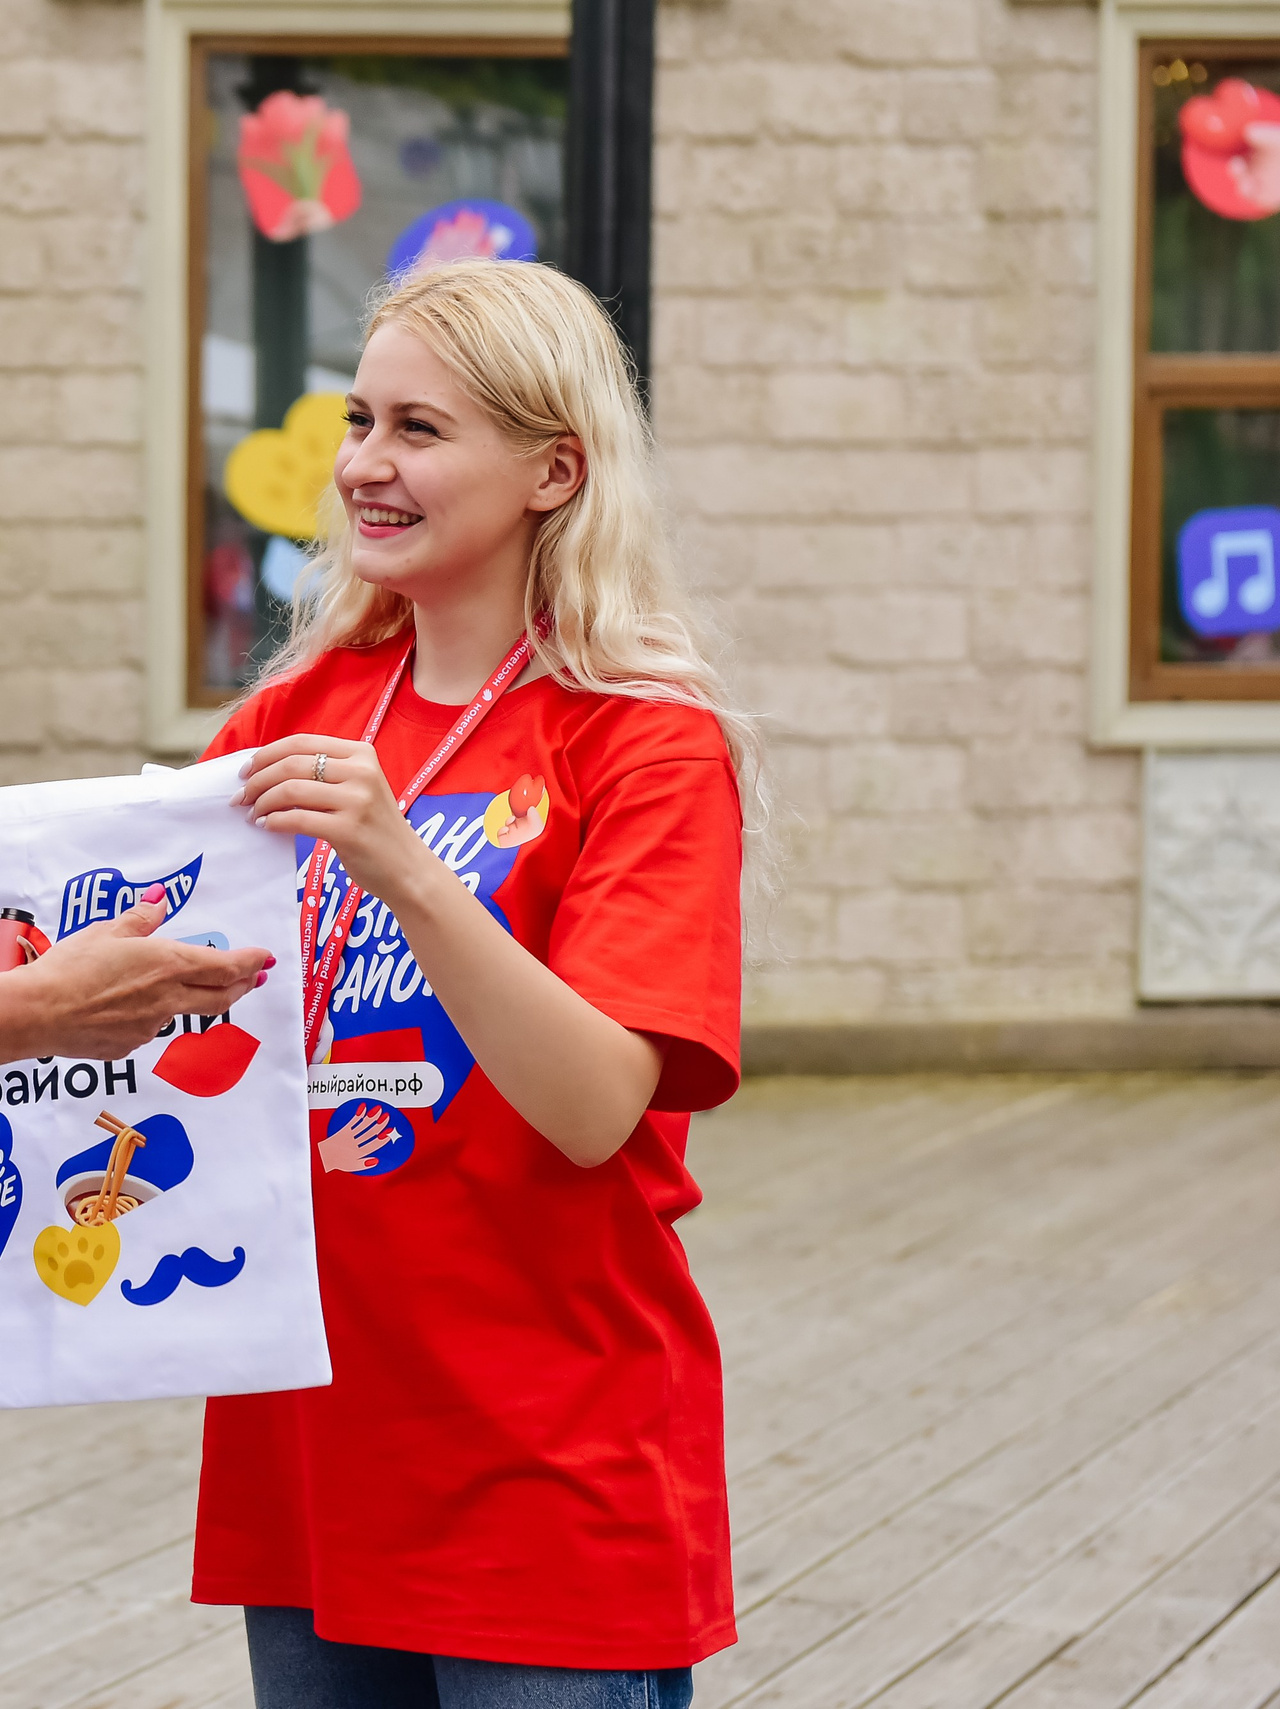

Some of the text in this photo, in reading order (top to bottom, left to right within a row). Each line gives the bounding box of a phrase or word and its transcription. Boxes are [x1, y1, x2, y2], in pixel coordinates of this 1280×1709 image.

[492, 627, 539, 687] неспальн
[407, 702, 482, 796] неспальный район
[311, 854, 324, 890] район
[64, 872, 114, 934] НЕ
[320, 942, 337, 979] район
